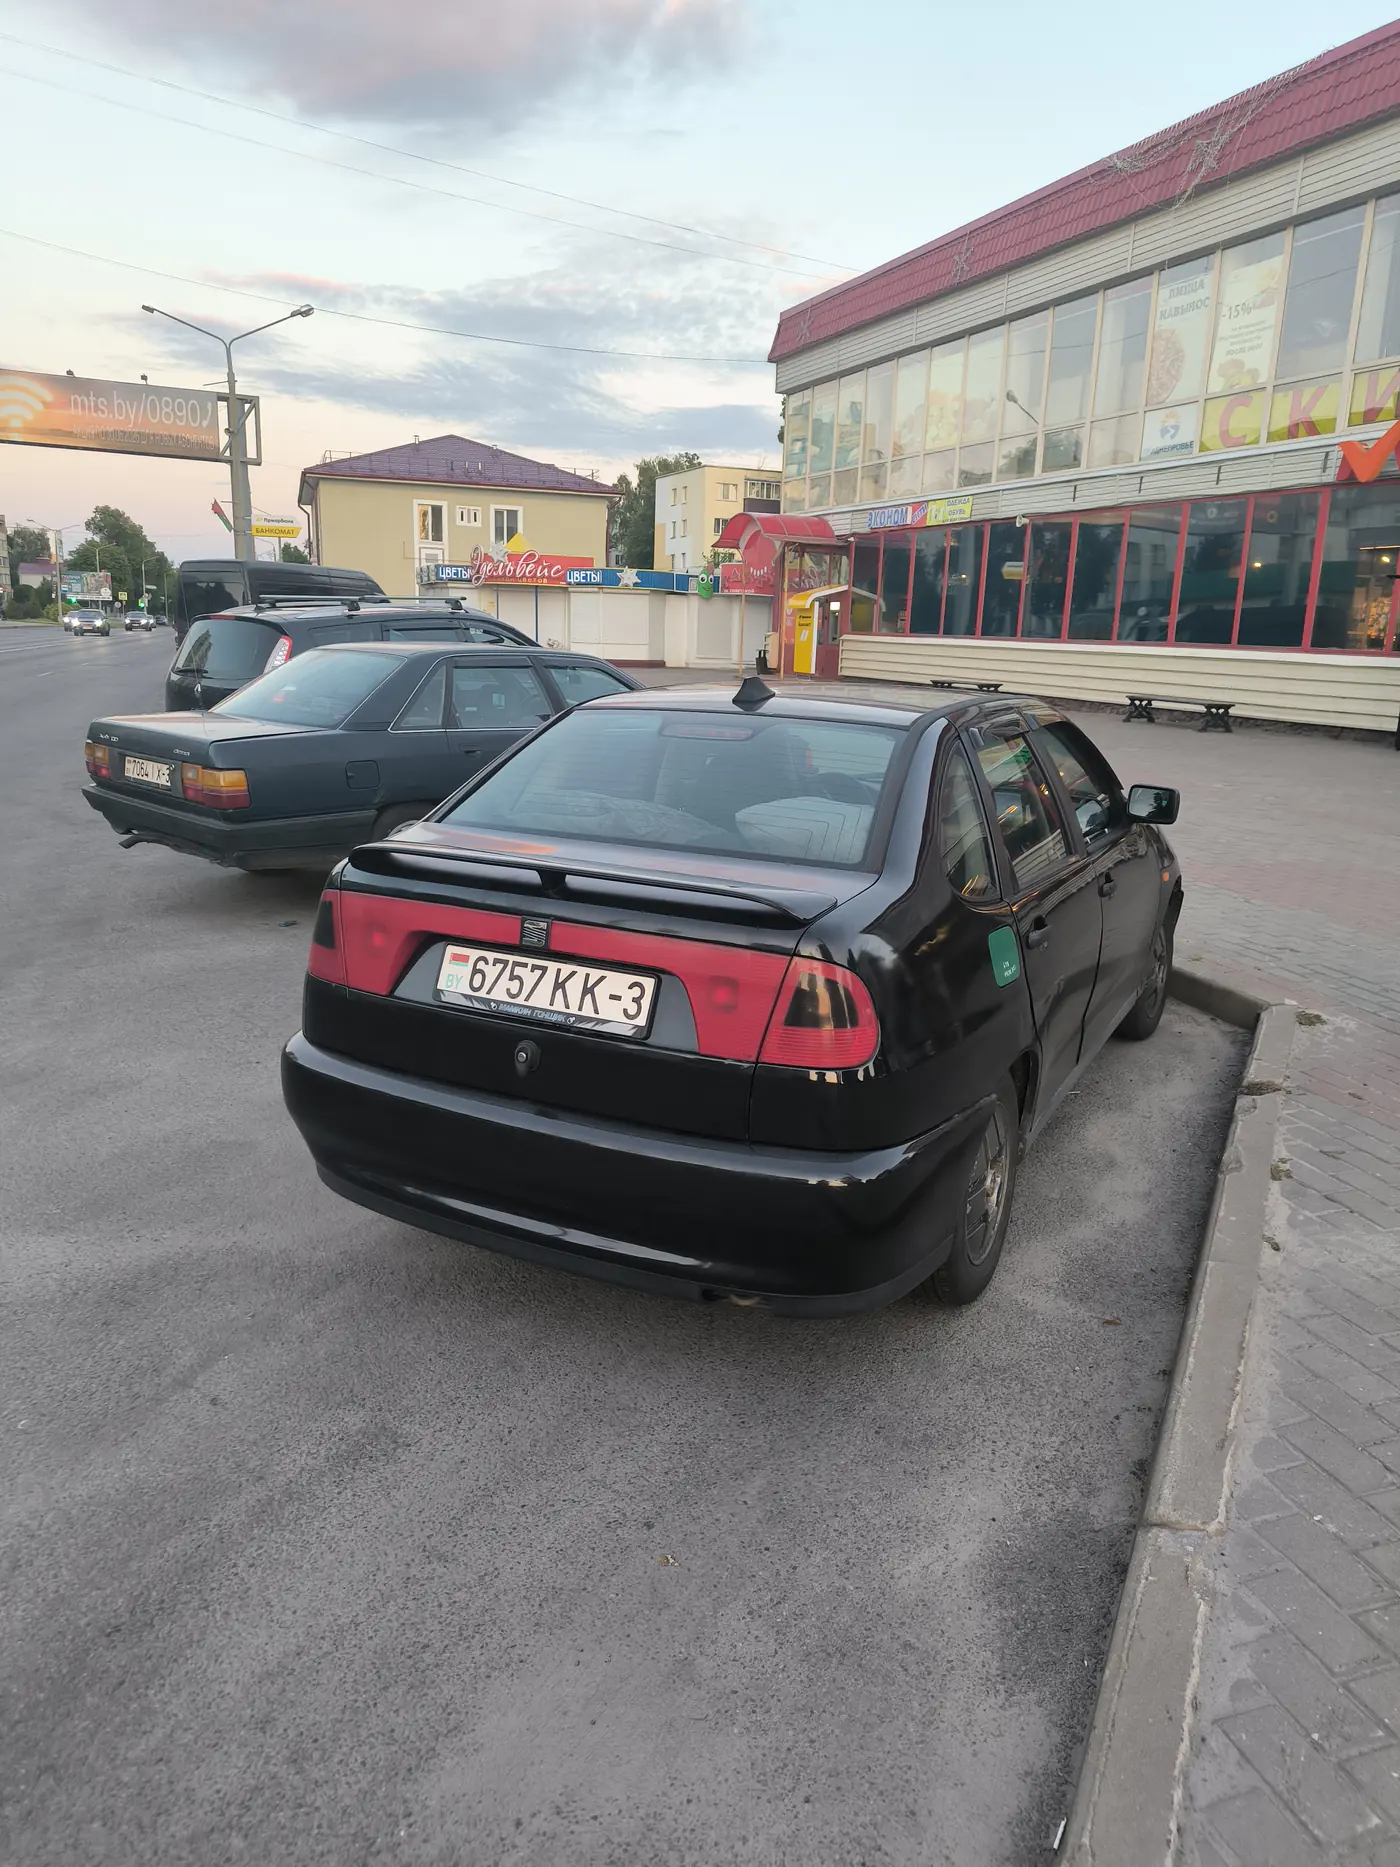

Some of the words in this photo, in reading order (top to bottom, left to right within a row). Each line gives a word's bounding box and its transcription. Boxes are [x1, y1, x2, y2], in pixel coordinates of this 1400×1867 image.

[1222, 301, 1251, 319] -15%
[70, 390, 200, 427] mts.by/0890
[947, 497, 970, 506] ОДЕЖДА
[868, 507, 909, 527] ЭКОНОМ
[948, 508, 966, 516] ОБУВЬ
[255, 527, 295, 535] БАНКОМАТ
[470, 544, 565, 586] Эдельвейс
[439, 566, 471, 580] ЦВЕТЫ
[567, 569, 600, 583] ЦВЕТЫ
[445, 973, 464, 990] BY
[533, 1009, 566, 1022] ГОНЩИК
